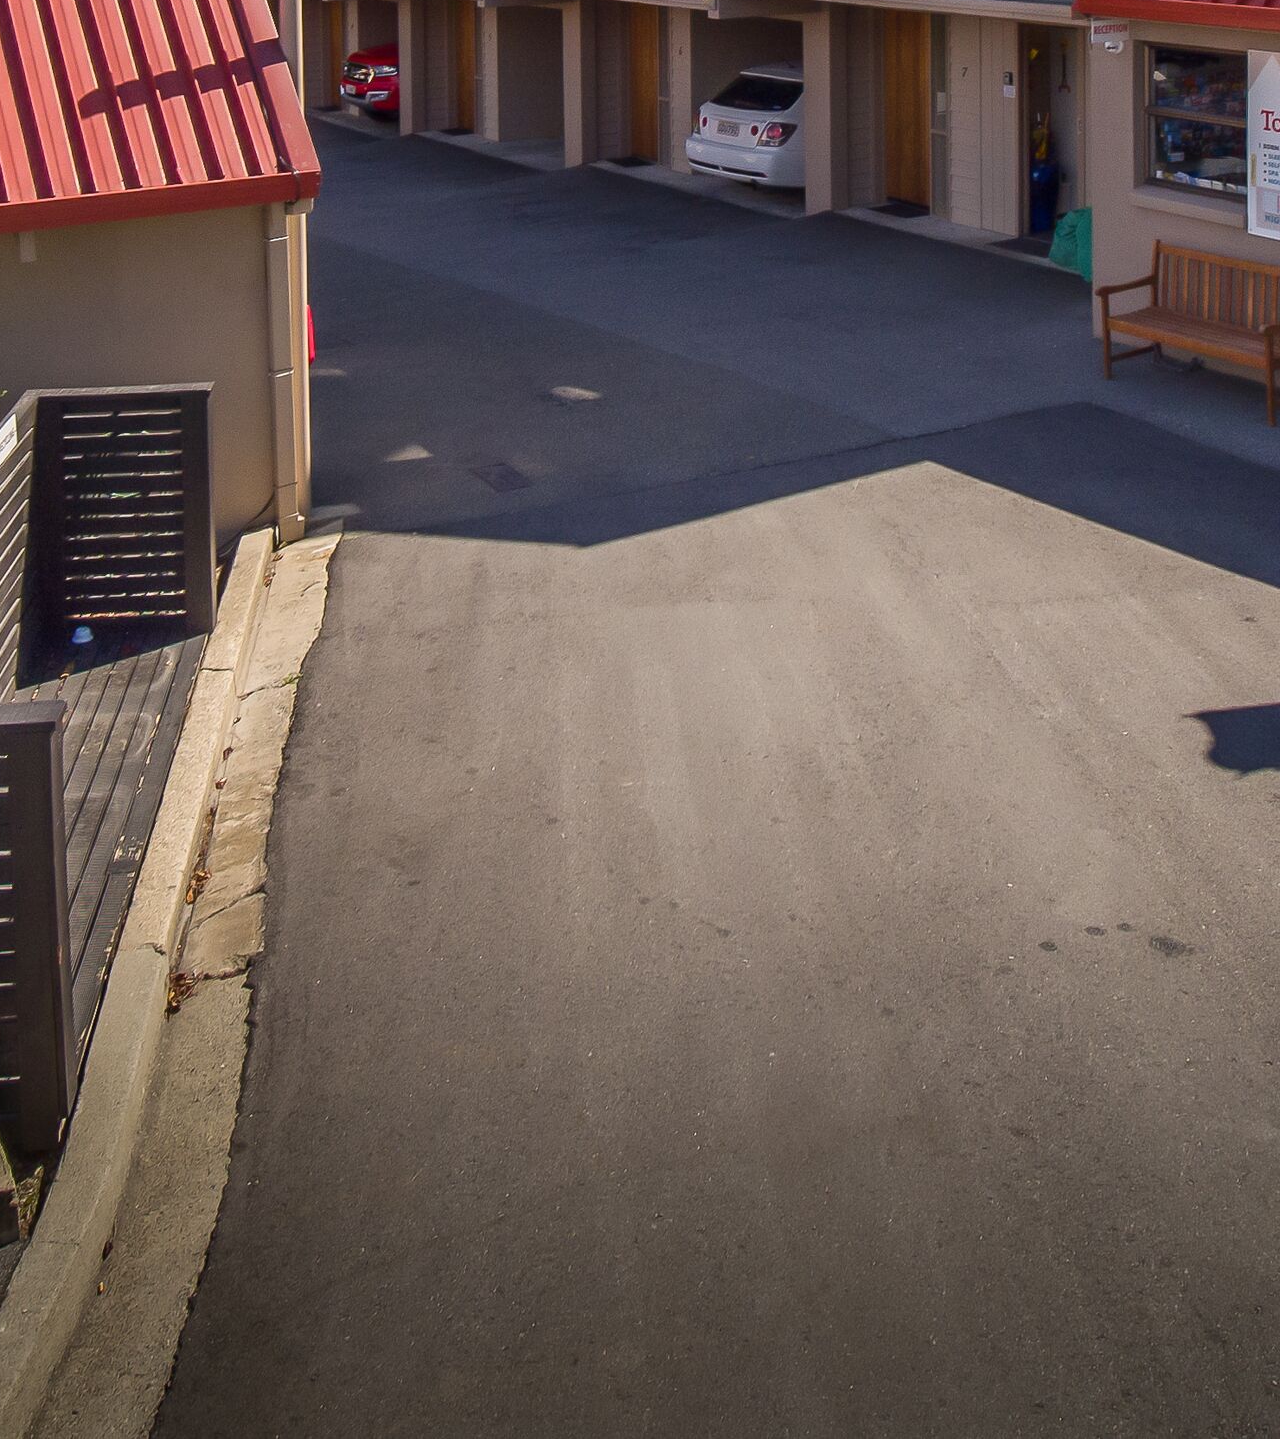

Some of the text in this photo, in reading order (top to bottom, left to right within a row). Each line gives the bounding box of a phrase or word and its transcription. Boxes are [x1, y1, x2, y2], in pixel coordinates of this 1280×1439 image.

[961, 66, 969, 78] 7
[1268, 161, 1280, 169] SELF
[1268, 169, 1279, 177] SPA
